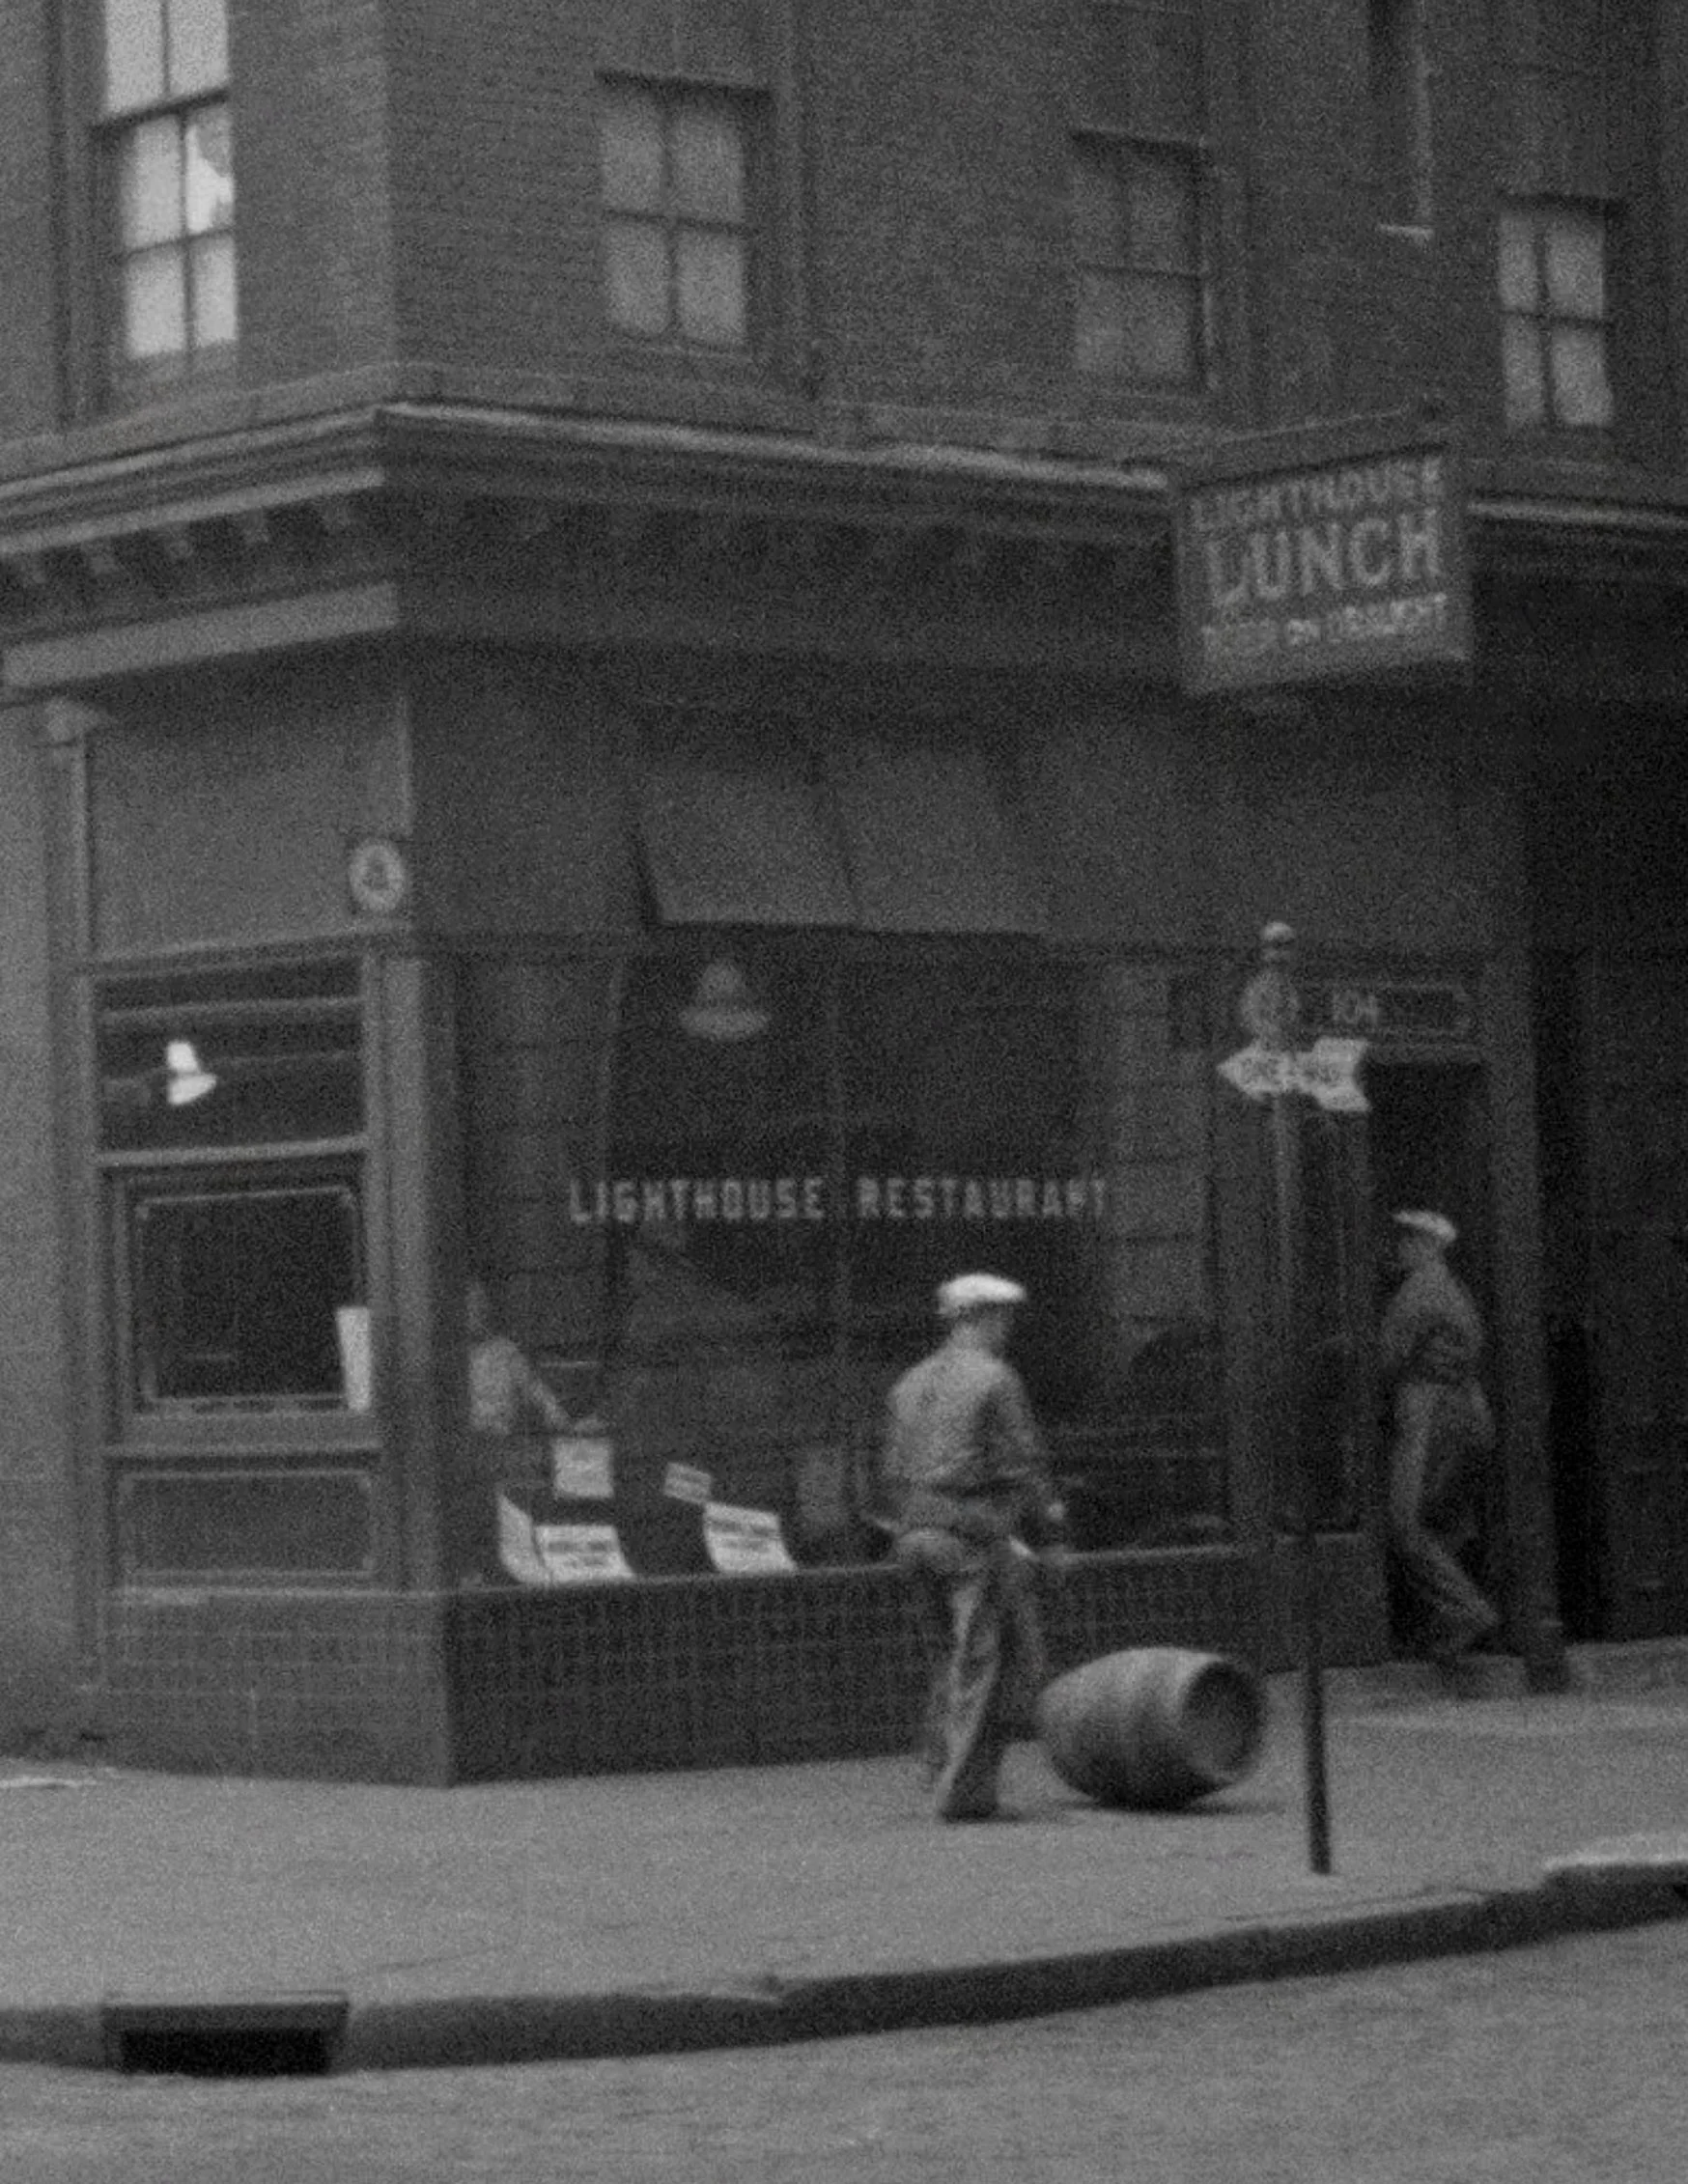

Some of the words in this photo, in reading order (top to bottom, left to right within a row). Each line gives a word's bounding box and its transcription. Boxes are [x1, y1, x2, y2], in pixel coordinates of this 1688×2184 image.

[1191, 456, 1445, 533] LIGHTHOUSE
[1204, 507, 1446, 608] LUNCH
[568, 1175, 828, 1225] LIGHTHOUSE
[856, 1175, 1109, 1221] RESTAURANT
